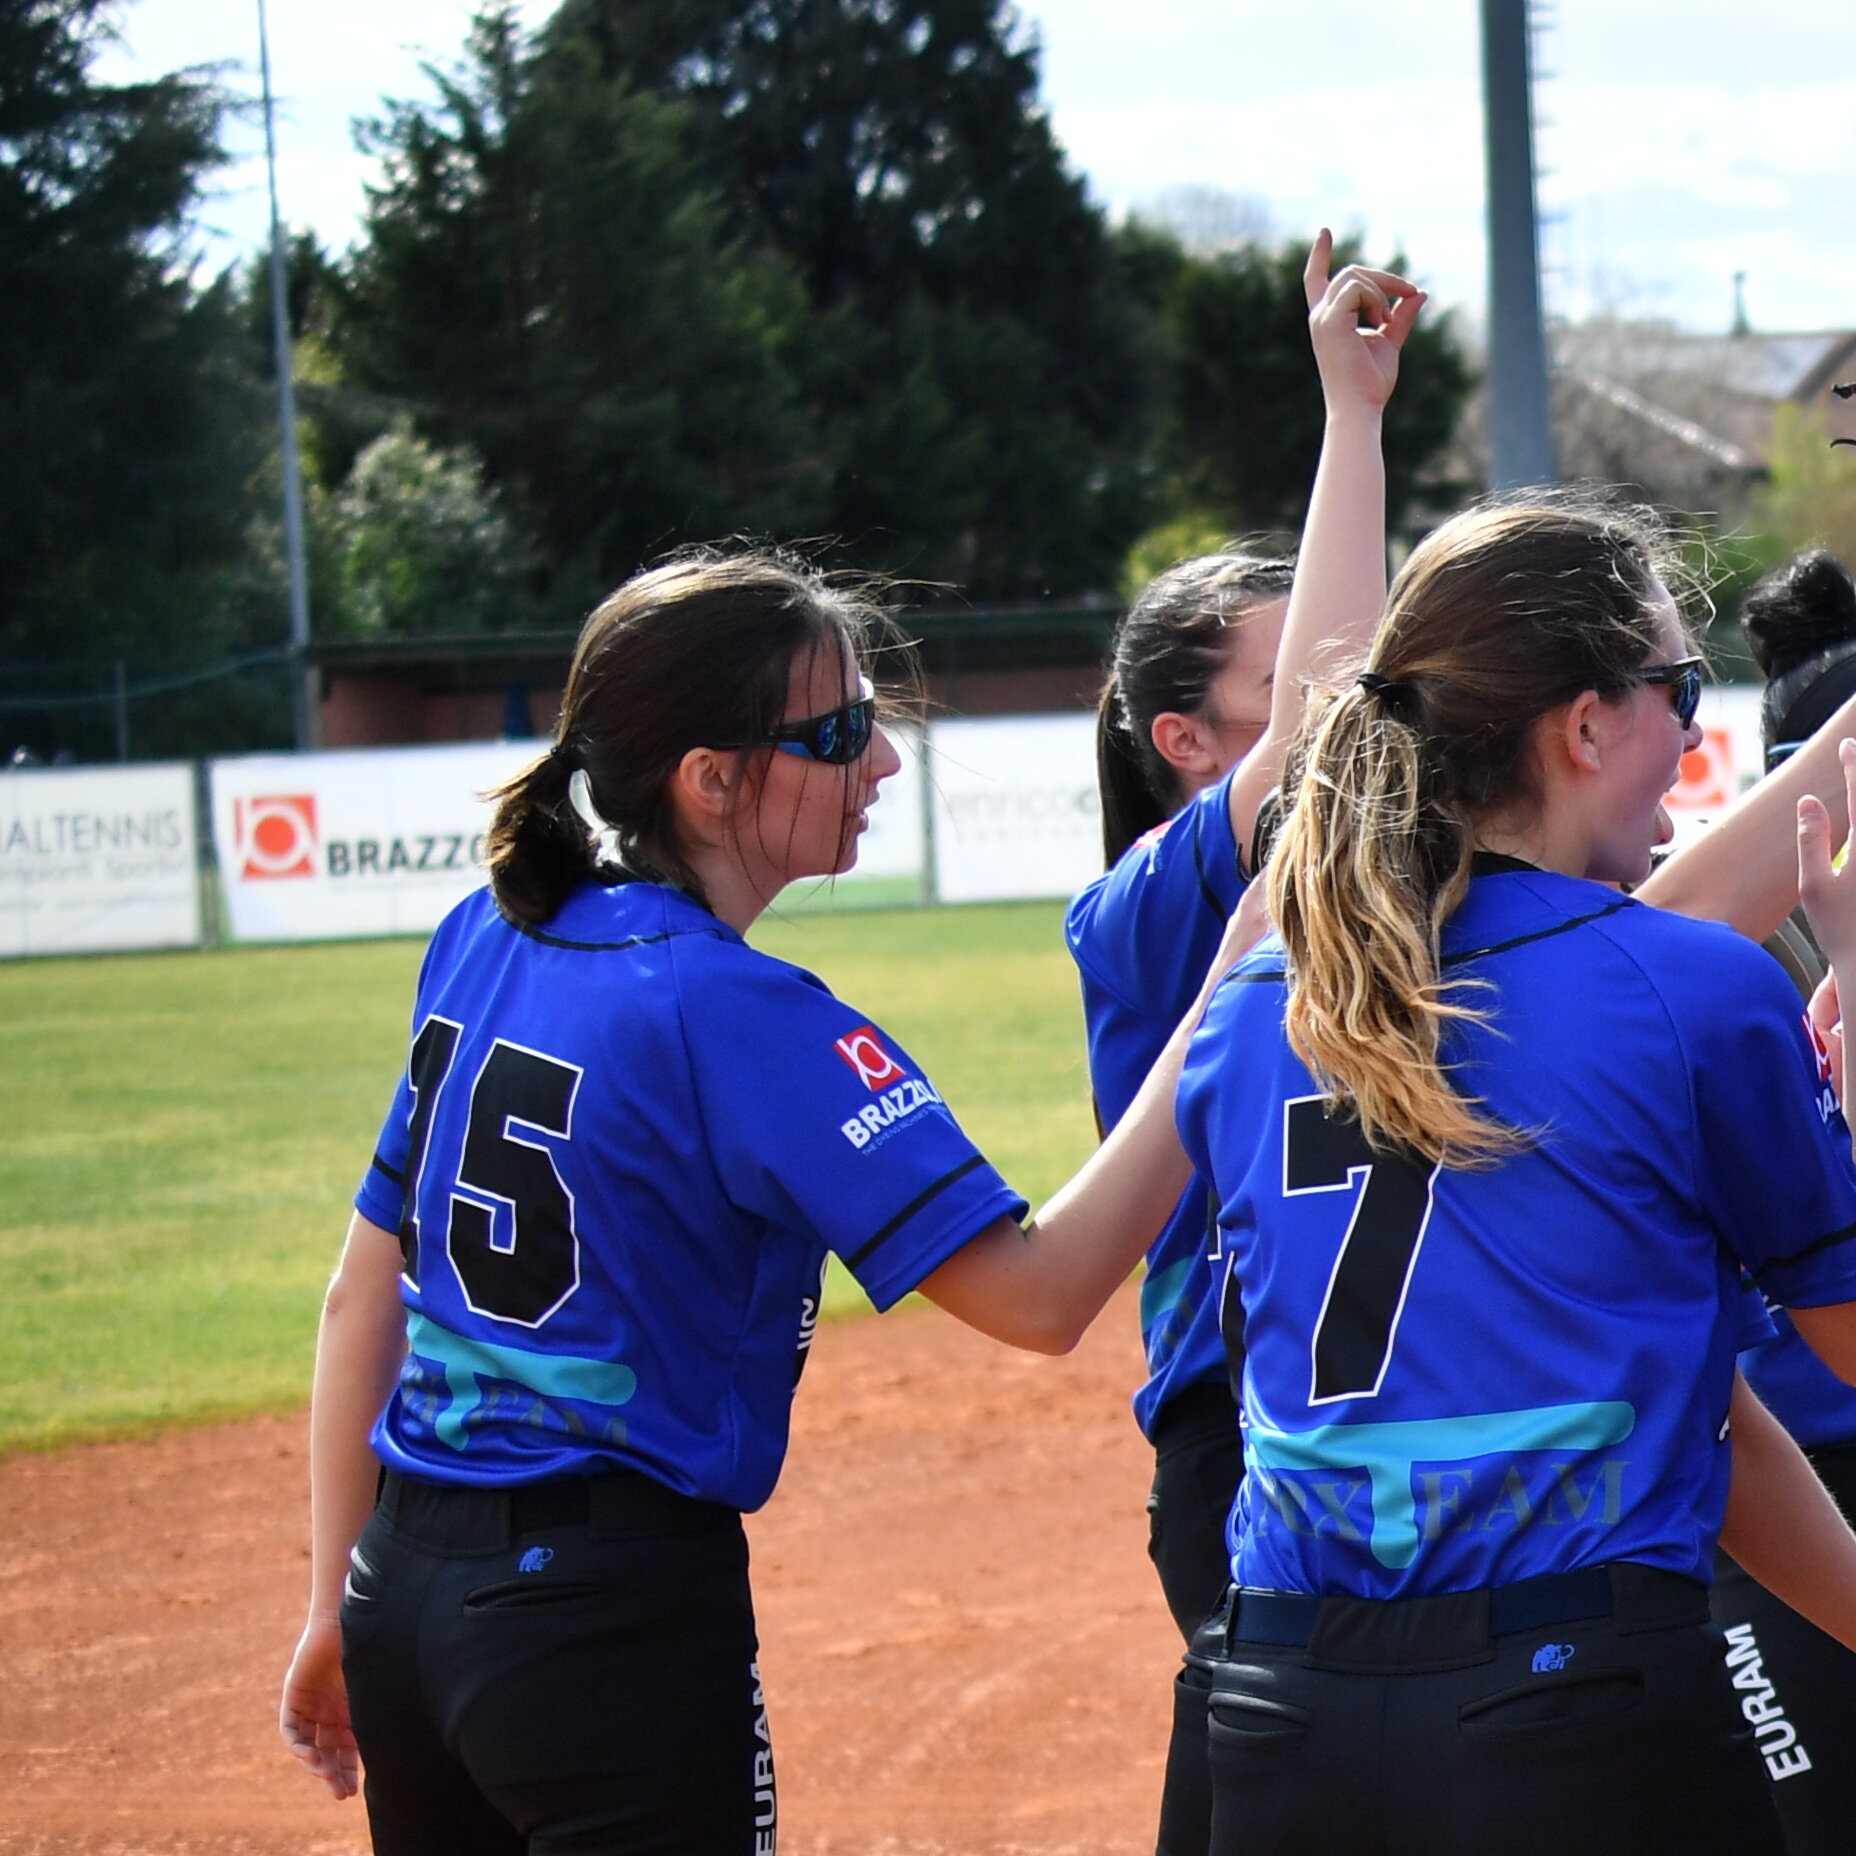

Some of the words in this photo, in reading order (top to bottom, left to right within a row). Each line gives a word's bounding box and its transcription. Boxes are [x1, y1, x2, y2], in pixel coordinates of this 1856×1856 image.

[6, 810, 182, 855] ALTENNIS
[327, 833, 488, 876] BRAZZO
[401, 1015, 584, 1328] 15
[1282, 1093, 1446, 1407] 7
[1723, 1623, 1812, 1782] EURAM
